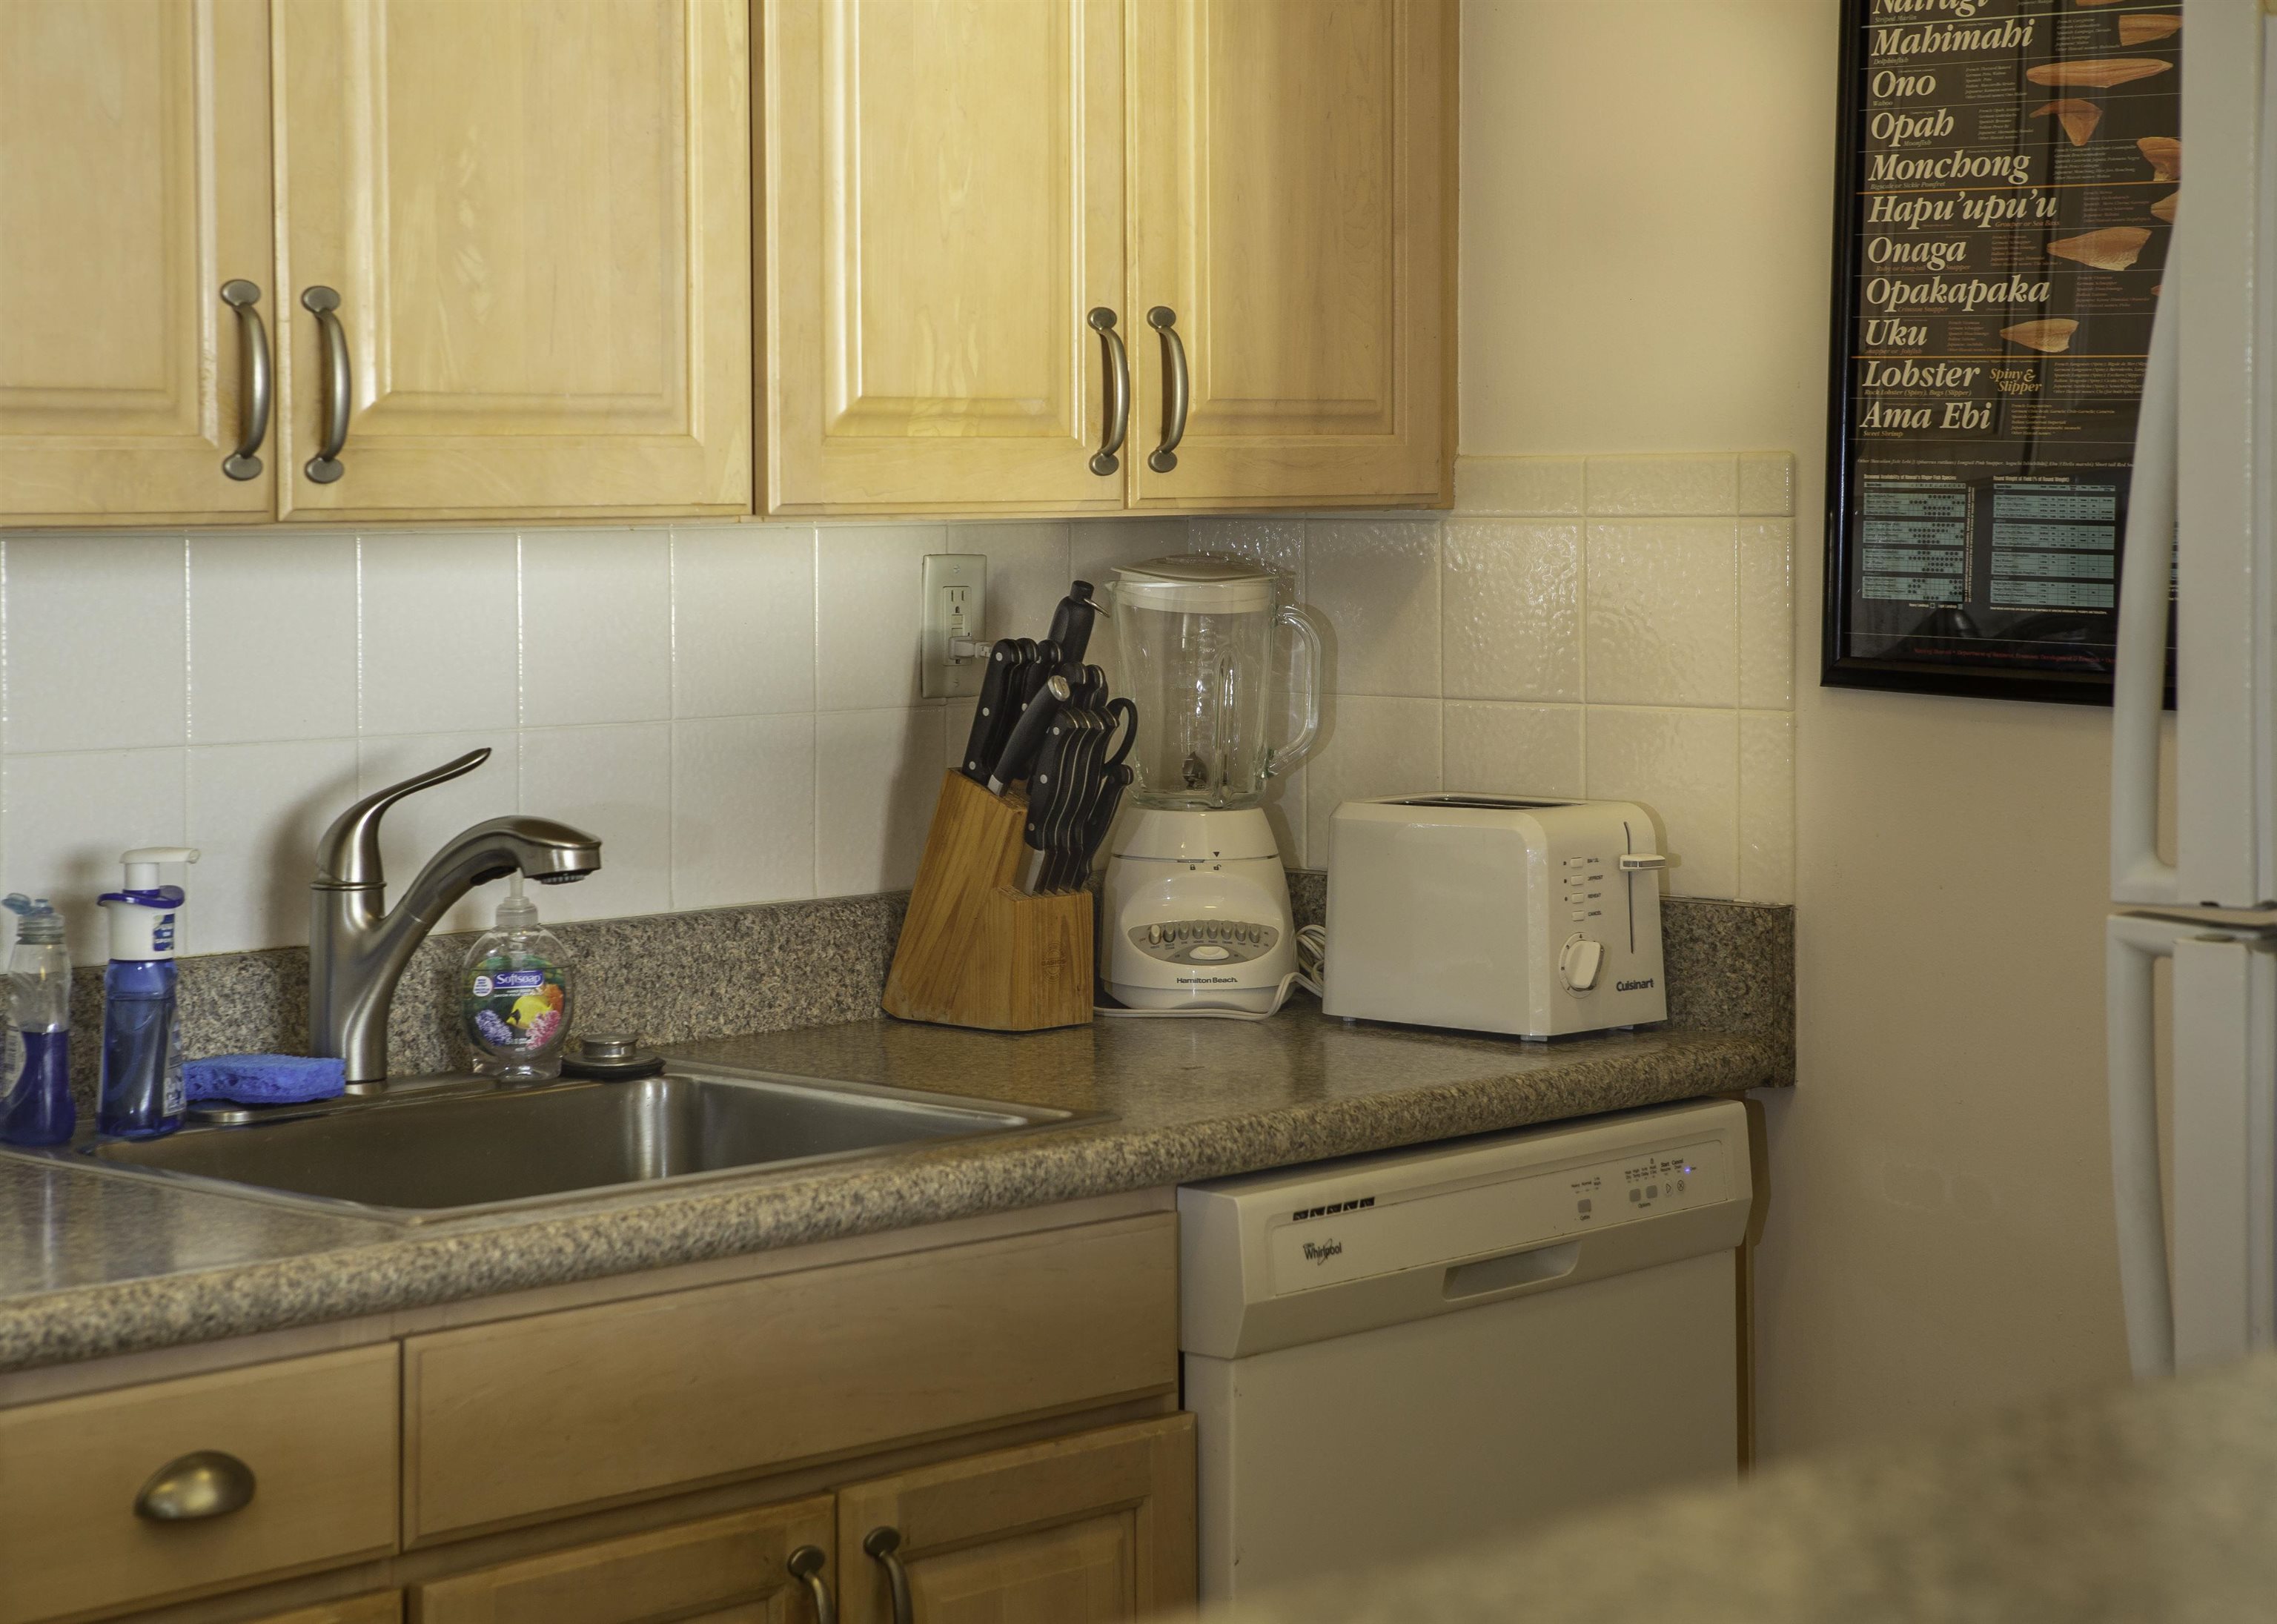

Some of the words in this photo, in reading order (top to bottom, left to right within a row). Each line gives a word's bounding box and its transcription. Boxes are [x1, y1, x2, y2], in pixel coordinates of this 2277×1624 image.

[1871, 19, 2035, 56] Mahimahi
[1874, 57, 1909, 66] Dolphinfish
[1872, 70, 1937, 98] Ono
[1871, 108, 1955, 148] Opah
[1868, 150, 2032, 185] Monchong
[1868, 236, 1967, 271] Onaga
[1946, 264, 1971, 273] Snapper
[1866, 274, 2050, 313] Opakapaka
[1924, 306, 1949, 314] Snapper
[1865, 318, 1928, 346] Uku
[1862, 359, 1981, 388] Lobster
[1989, 368, 2023, 383] Spiny
[2024, 369, 2036, 382] &
[1998, 381, 2042, 395] Slipper
[1859, 401, 1932, 428] Ama
[1939, 401, 1992, 429] Ebi
[1881, 430, 1904, 439] Shrimp
[495, 972, 541, 986] Softsoap
[1616, 978, 1654, 992] Cuisinart
[1303, 1242, 1342, 1261] Whirlpool
